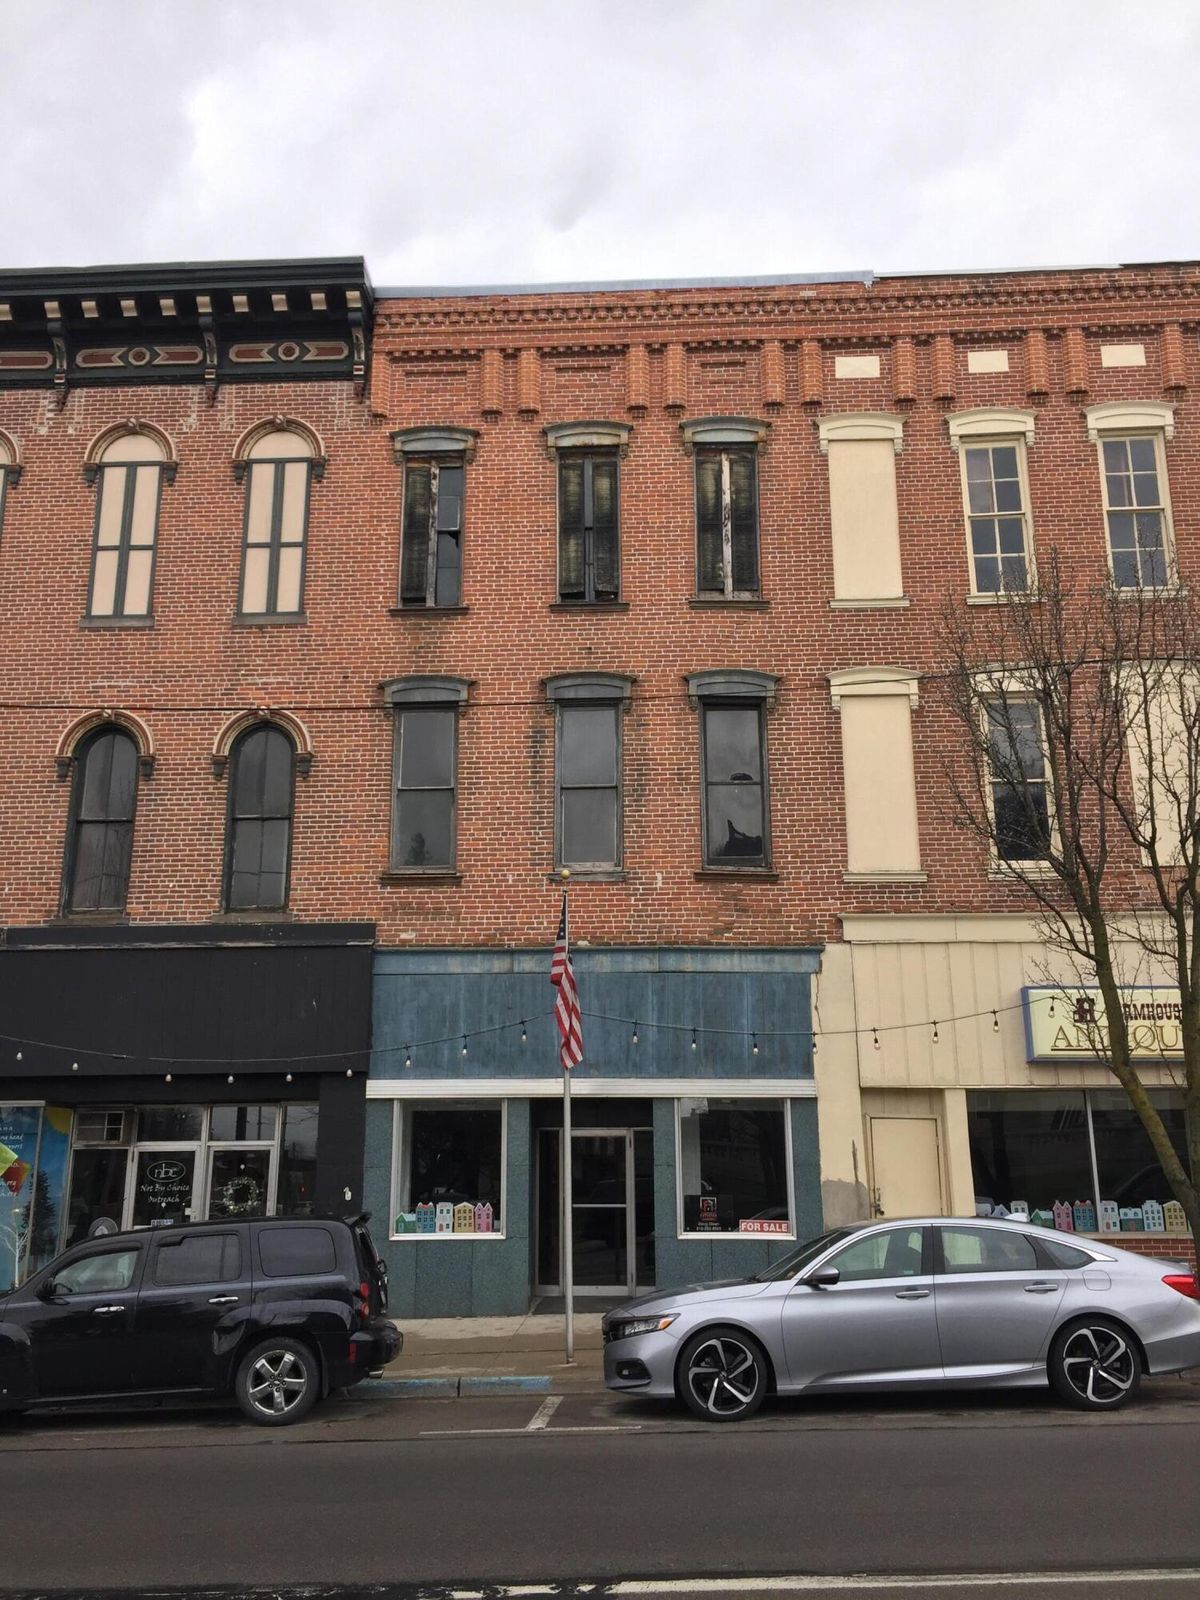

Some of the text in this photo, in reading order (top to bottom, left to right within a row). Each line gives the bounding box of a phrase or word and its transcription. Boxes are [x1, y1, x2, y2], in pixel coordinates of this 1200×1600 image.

[154, 1163, 178, 1178] nbc
[140, 1183, 190, 1195] Not By Choice
[149, 1194, 180, 1203] Outreach
[741, 1222, 788, 1232] FOR SALE
